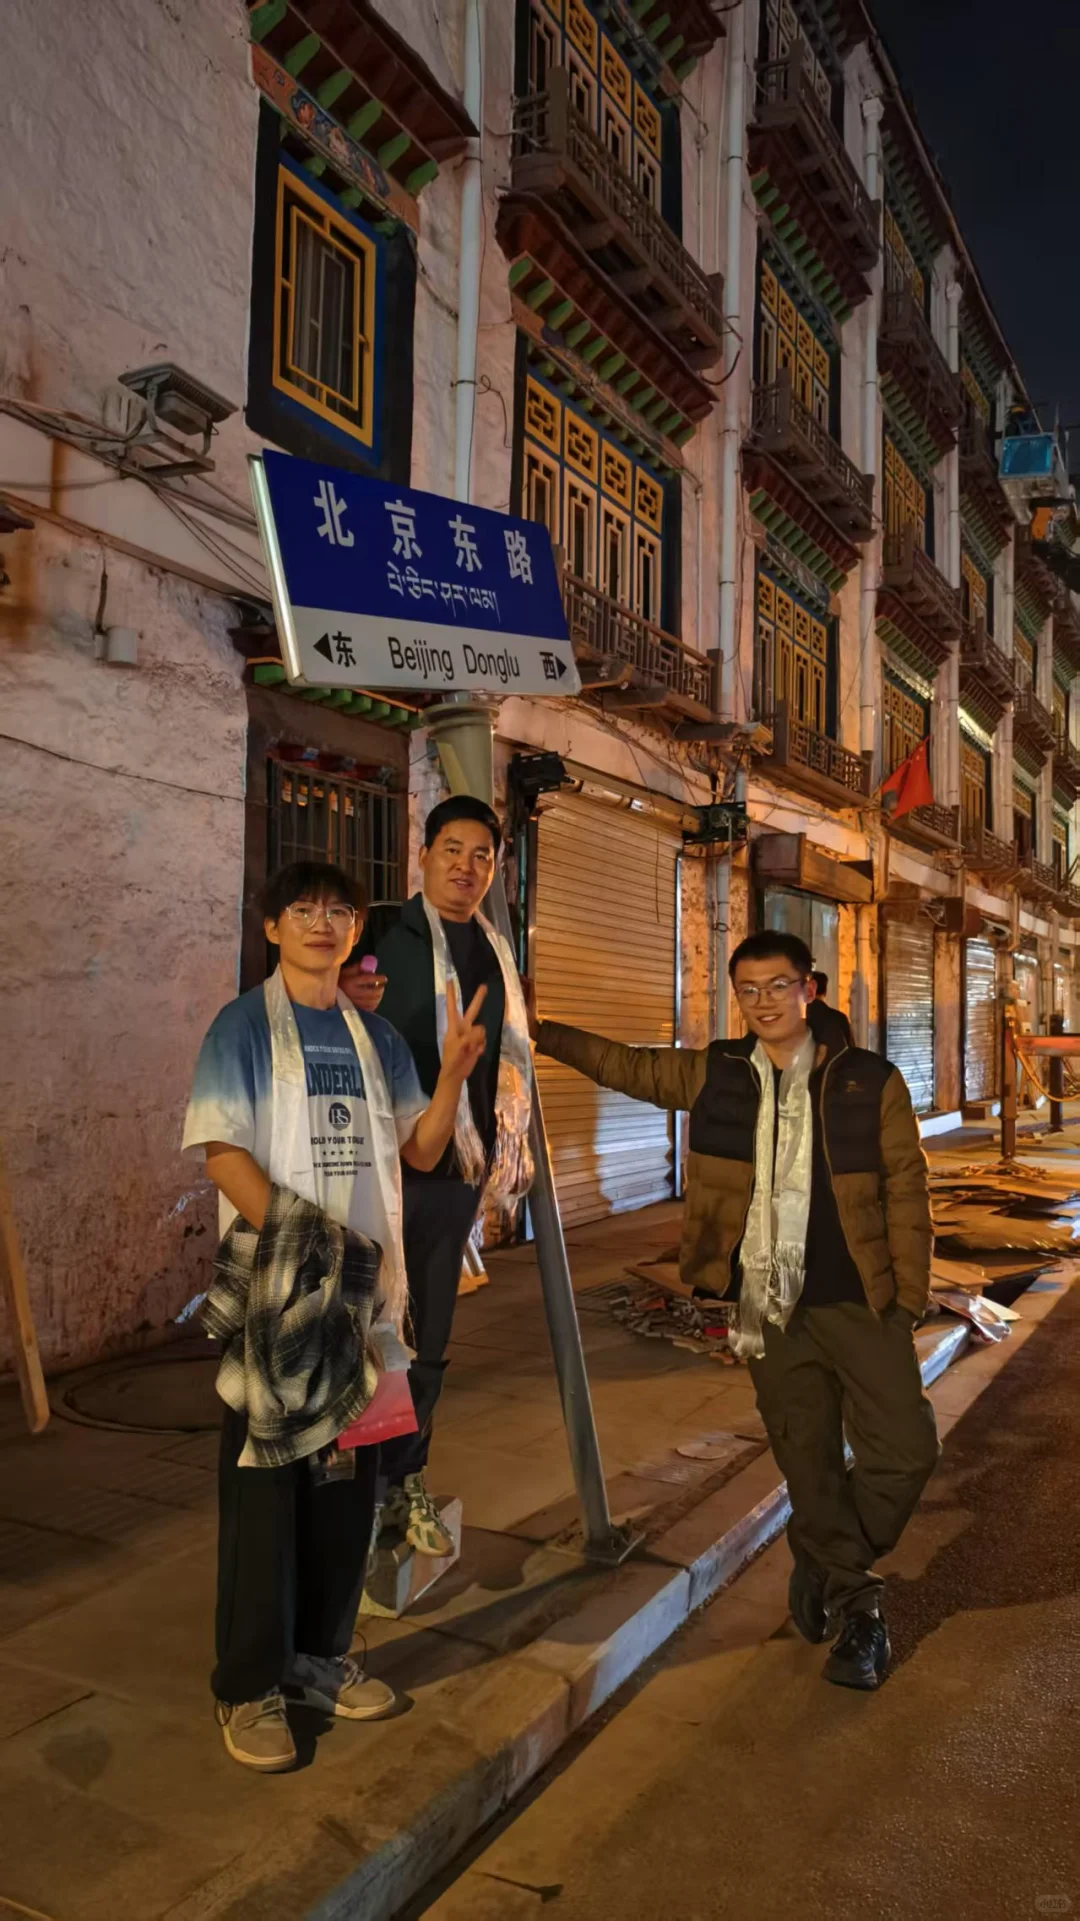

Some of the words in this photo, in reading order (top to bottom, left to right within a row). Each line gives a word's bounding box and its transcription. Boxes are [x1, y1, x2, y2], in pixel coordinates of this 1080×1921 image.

[313, 479, 533, 585] 北京东路
[332, 631, 357, 667] 东
[388, 636, 455, 681] Beijing
[462, 644, 520, 683] Donglu
[540, 651, 557, 680] 西
[306, 1063, 366, 1100] NDERL
